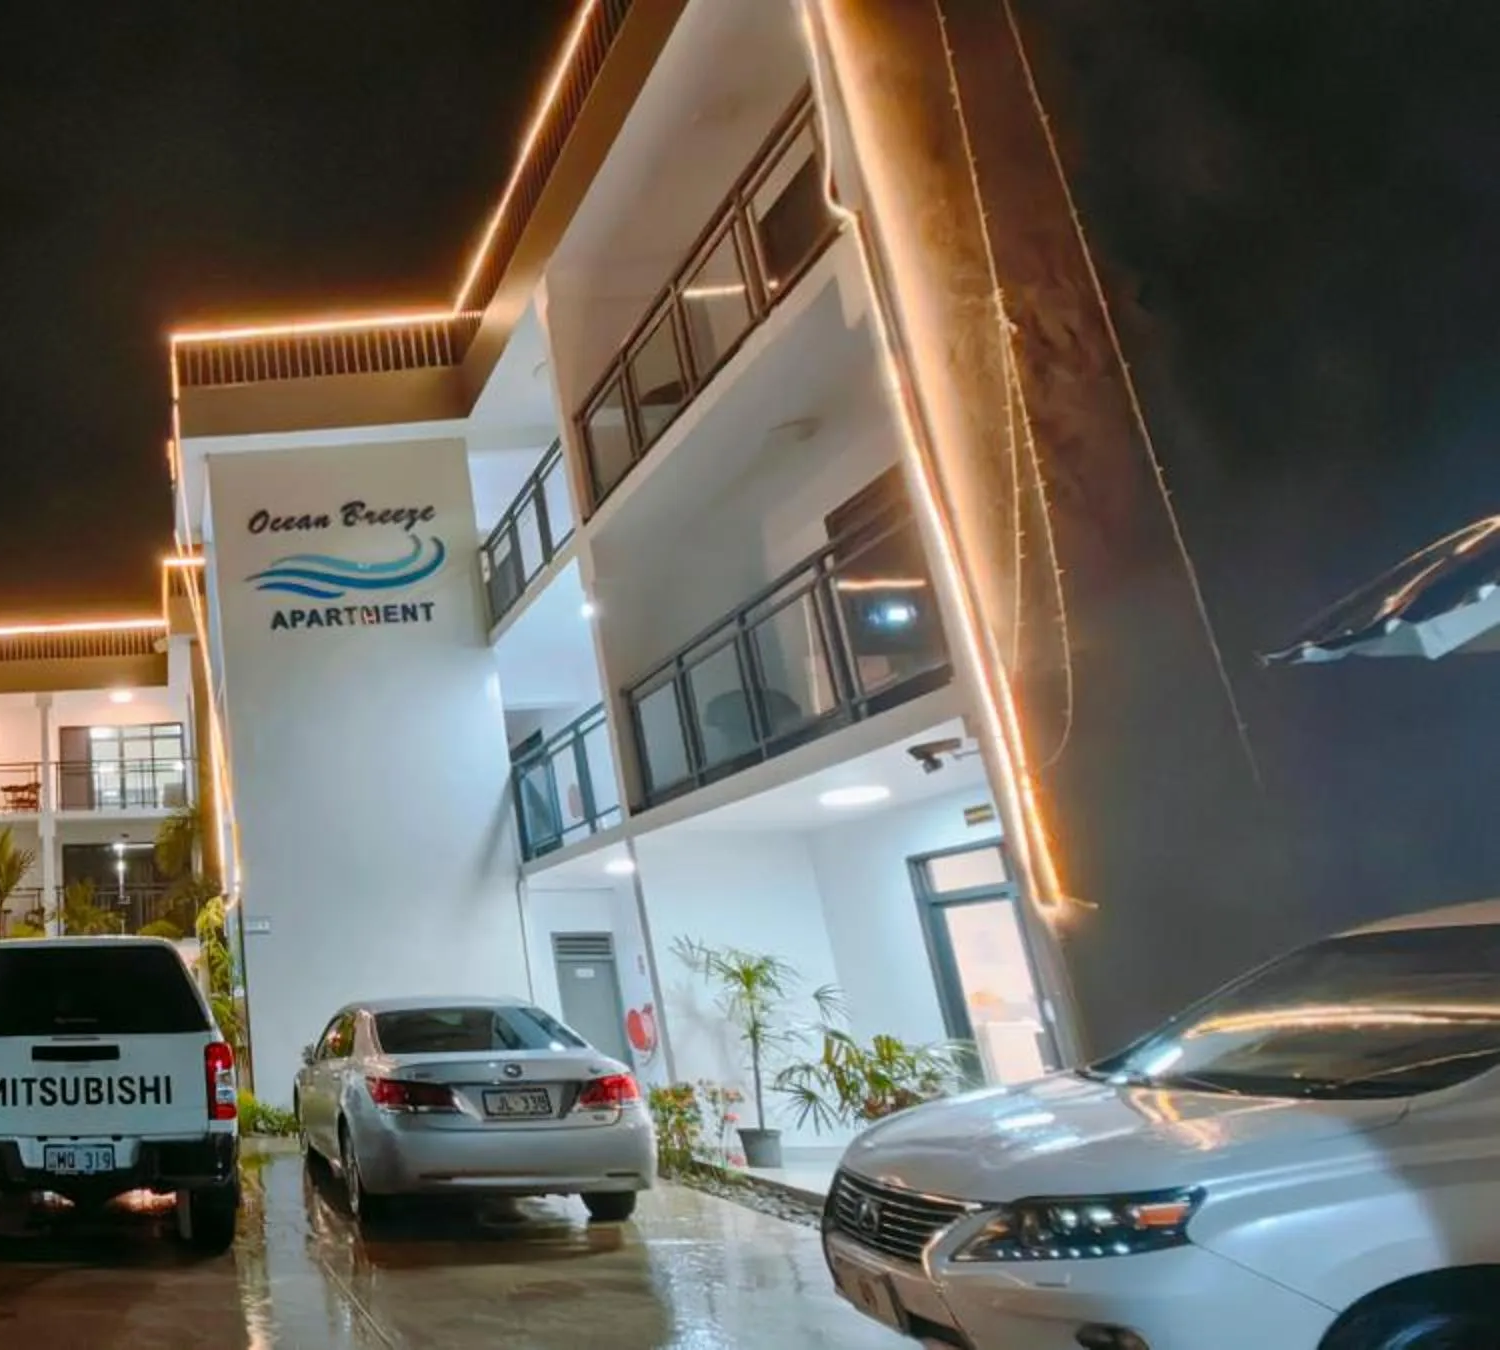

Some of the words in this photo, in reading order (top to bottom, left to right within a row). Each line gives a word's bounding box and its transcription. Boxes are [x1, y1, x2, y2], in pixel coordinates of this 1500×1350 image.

[248, 509, 331, 534] Ocean
[340, 500, 436, 531] Breeze
[270, 602, 435, 630] APARTMENT
